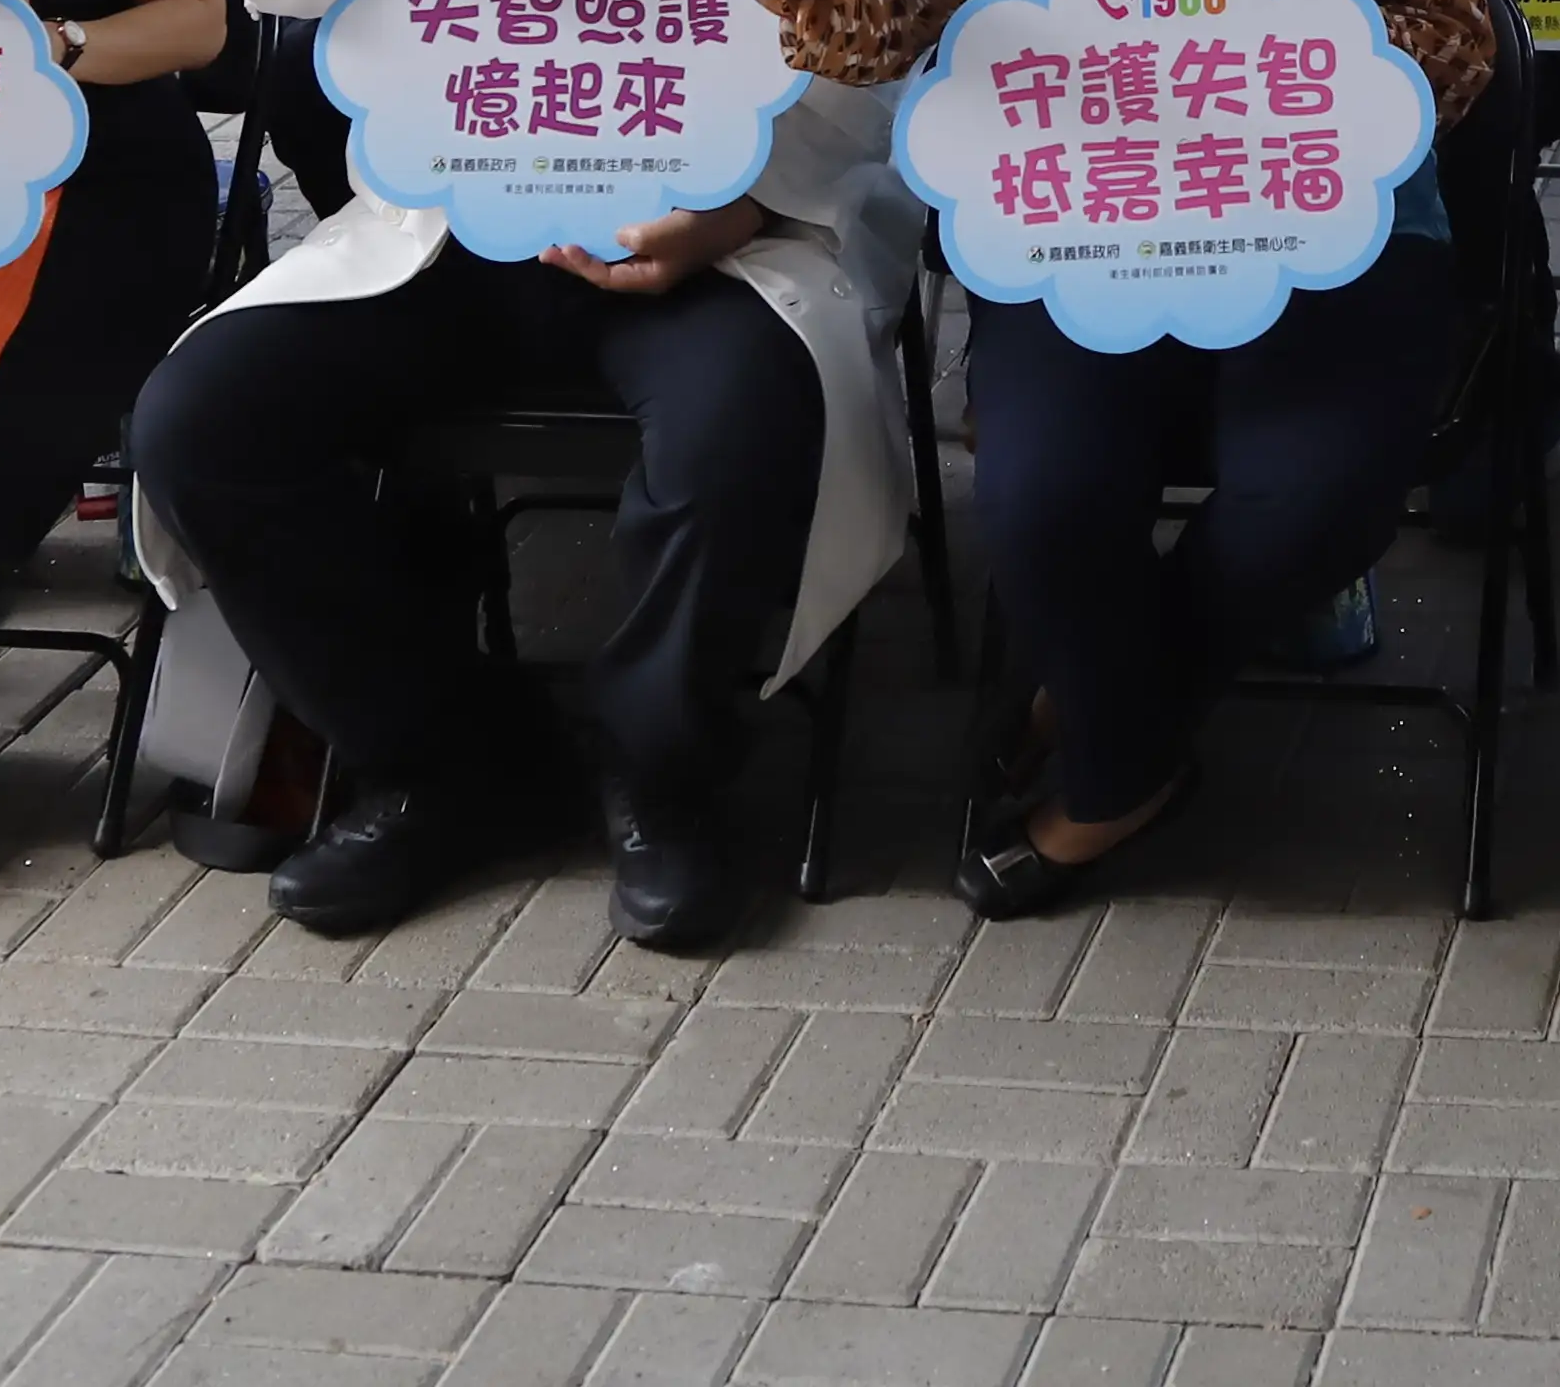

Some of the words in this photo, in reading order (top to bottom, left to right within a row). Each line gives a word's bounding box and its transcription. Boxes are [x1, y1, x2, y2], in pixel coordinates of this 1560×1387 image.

[445, 56, 687, 139] 憶起來
[990, 33, 1338, 131] 守護失智
[449, 157, 517, 173] 嘉義縣政府
[991, 128, 1344, 226] 抵嘉幸福
[1048, 244, 1122, 263] 嘉義縣政府
